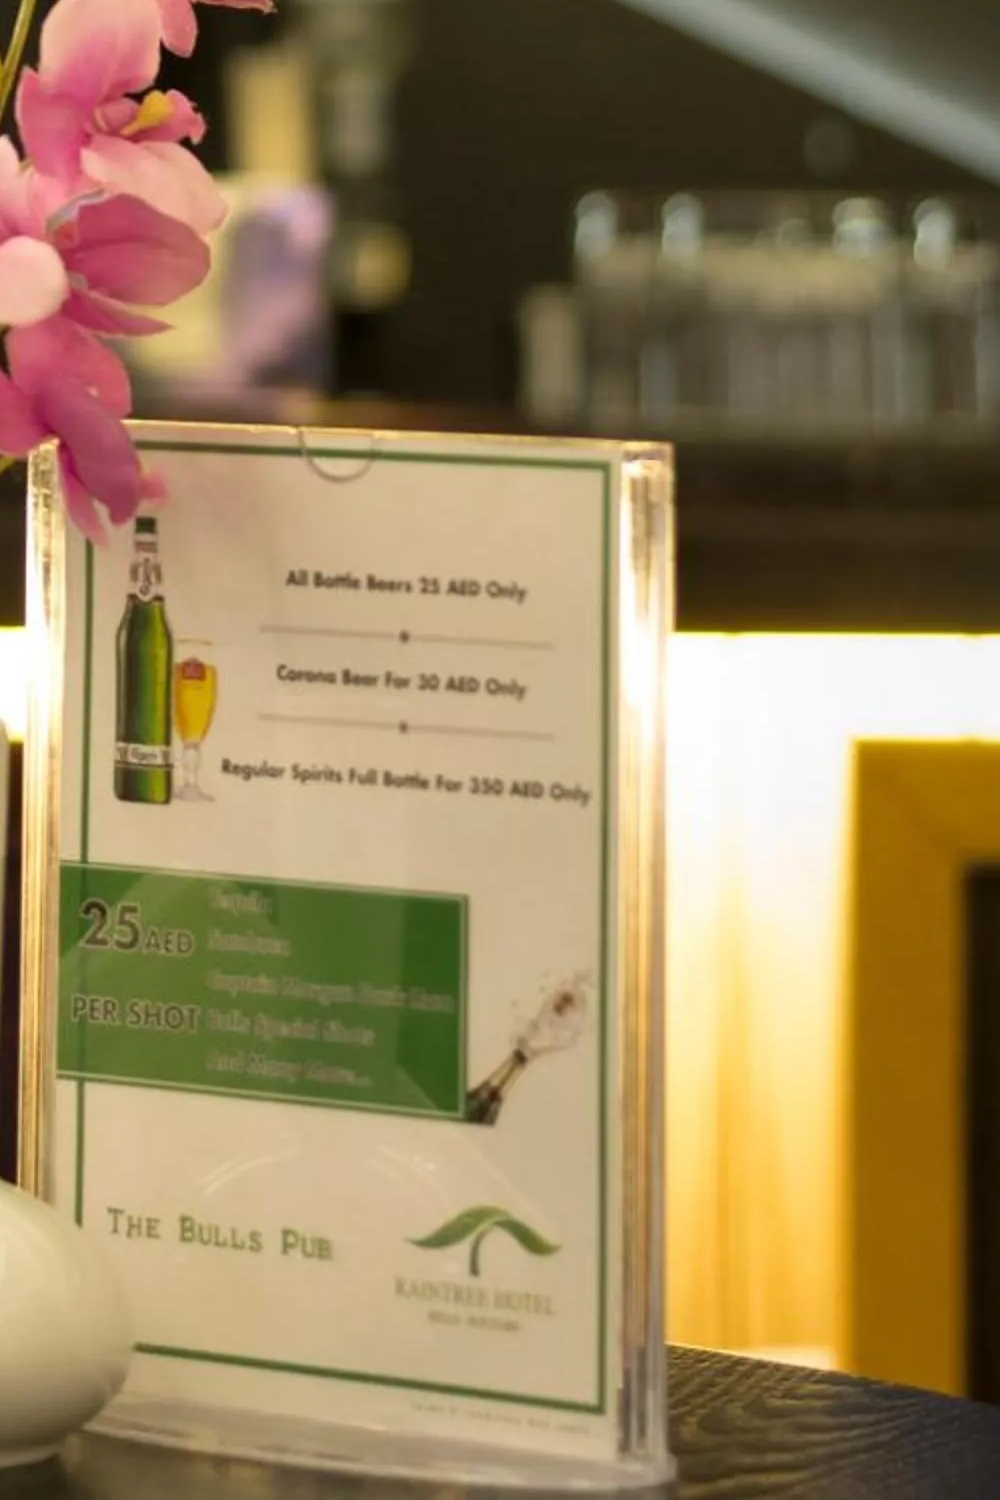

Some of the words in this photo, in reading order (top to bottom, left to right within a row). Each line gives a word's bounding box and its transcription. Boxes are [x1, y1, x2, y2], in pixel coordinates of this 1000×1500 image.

[286, 570, 308, 586] All
[314, 571, 360, 590] Bottle
[367, 574, 412, 593] Beers
[447, 579, 480, 596] AED
[486, 581, 528, 605] Only
[277, 664, 336, 684] Corona
[342, 669, 378, 687] Beer
[385, 671, 410, 688] For
[418, 674, 440, 691] 30
[446, 676, 480, 693] AED
[485, 678, 526, 701] Only
[221, 758, 285, 781] Regular
[292, 763, 343, 785] Spirits
[348, 768, 377, 785] Full
[383, 770, 429, 789] Bottle
[436, 774, 463, 792] For
[510, 780, 543, 798] AED
[550, 782, 591, 808] Only
[81, 899, 141, 950] 25
[144, 930, 194, 956] AED
[72, 994, 118, 1023] PER
[128, 1000, 200, 1031] SHOT
